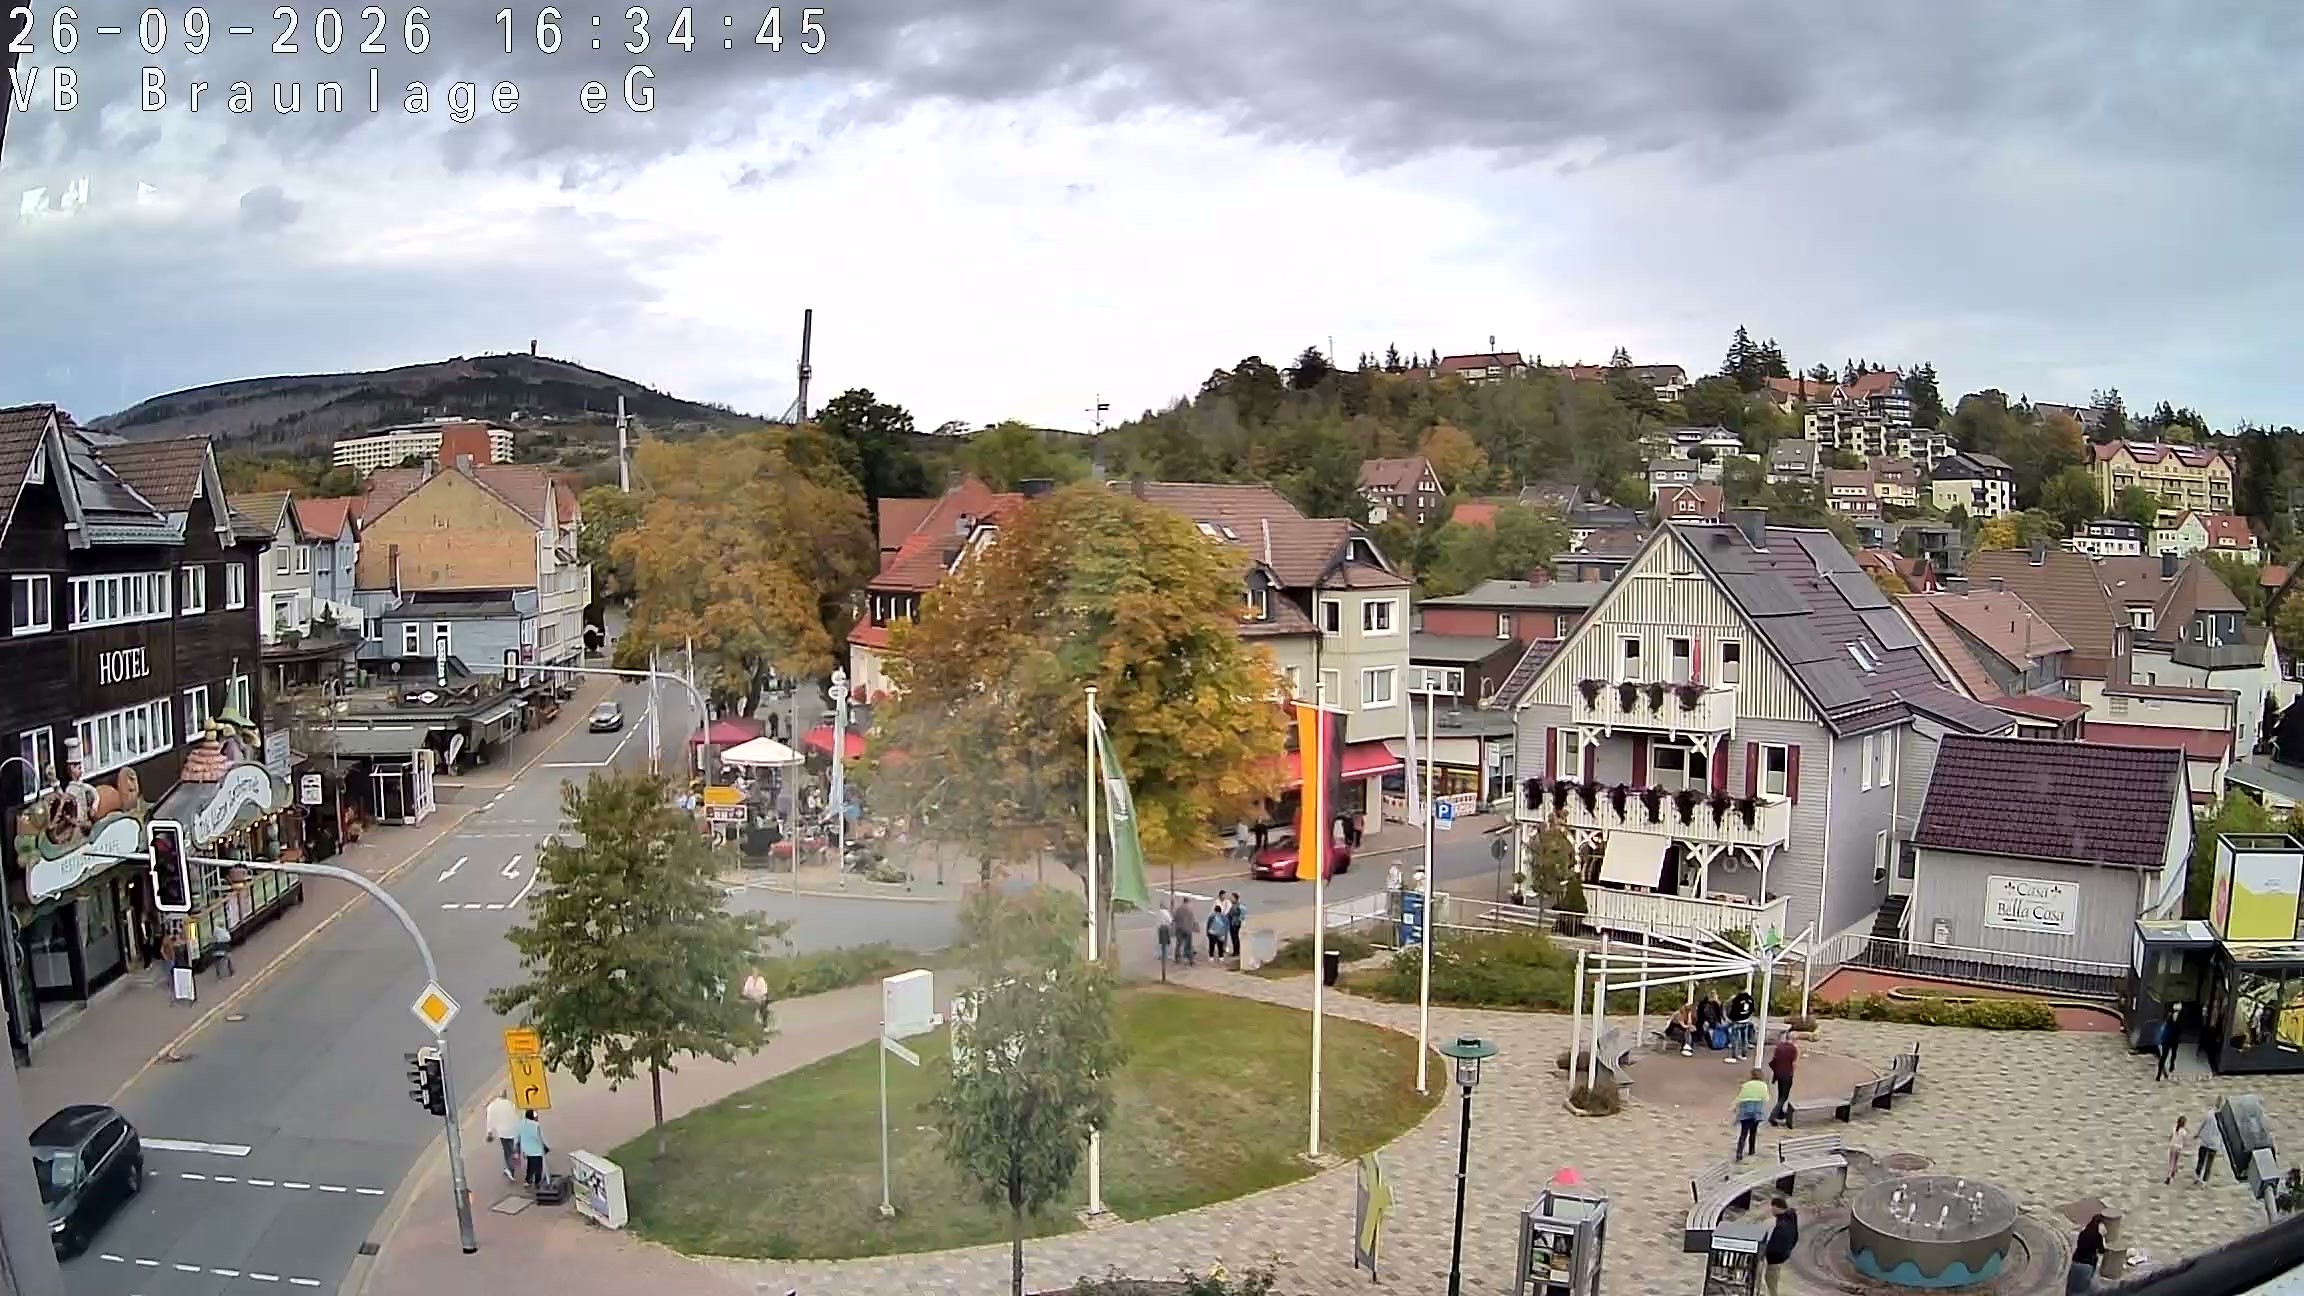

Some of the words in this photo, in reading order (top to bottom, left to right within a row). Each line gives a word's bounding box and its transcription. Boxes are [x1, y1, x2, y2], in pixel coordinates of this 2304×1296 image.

[99, 646, 150, 685] HOTEL
[1438, 804, 1449, 818] P
[1997, 898, 2029, 918] Bella
[523, 1063, 532, 1076] U
